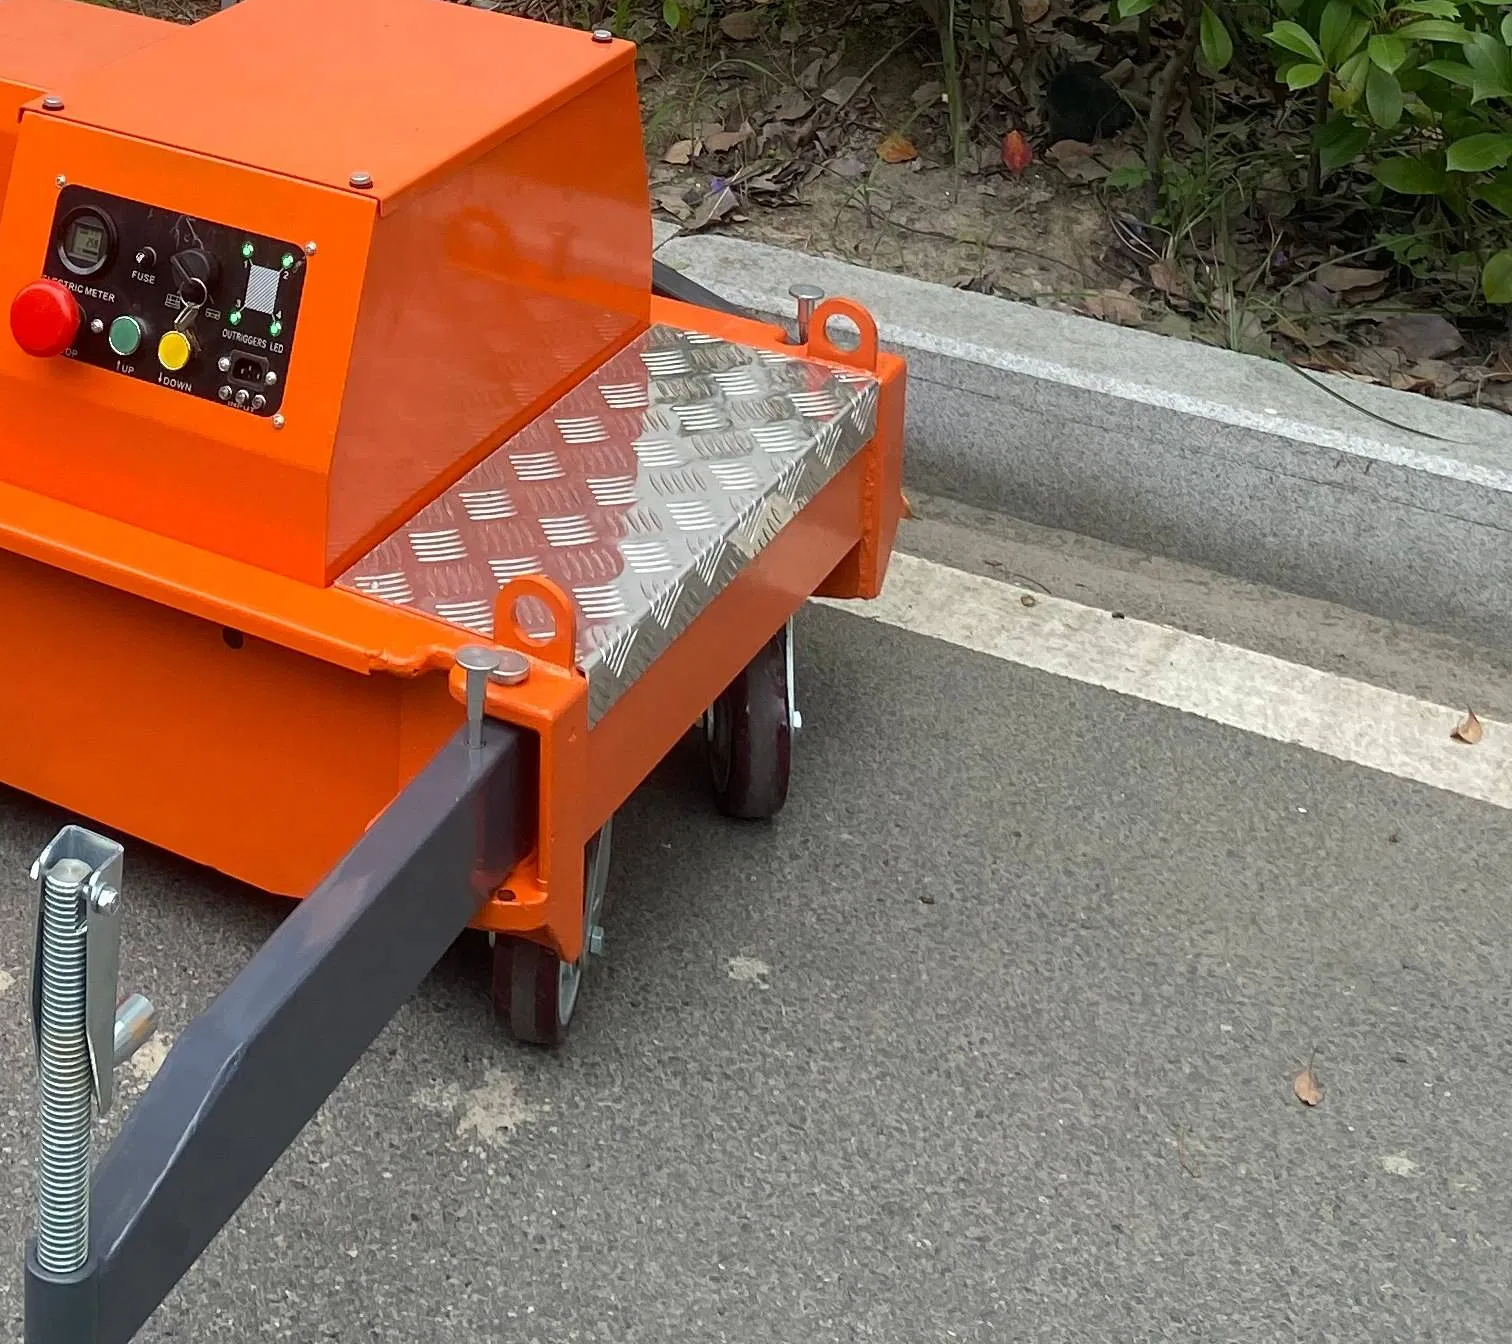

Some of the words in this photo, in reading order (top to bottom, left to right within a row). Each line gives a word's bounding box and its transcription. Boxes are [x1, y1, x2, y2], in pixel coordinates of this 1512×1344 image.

[243, 260, 248, 269] 1
[131, 270, 156, 285] FUSE
[282, 270, 290, 280] 2
[85, 285, 116, 303] METER
[275, 310, 282, 320] 4
[222, 328, 267, 349] OUTRIGGERS
[269, 341, 284, 354] LED
[121, 365, 135, 375] UP
[163, 376, 193, 393] DOWN
